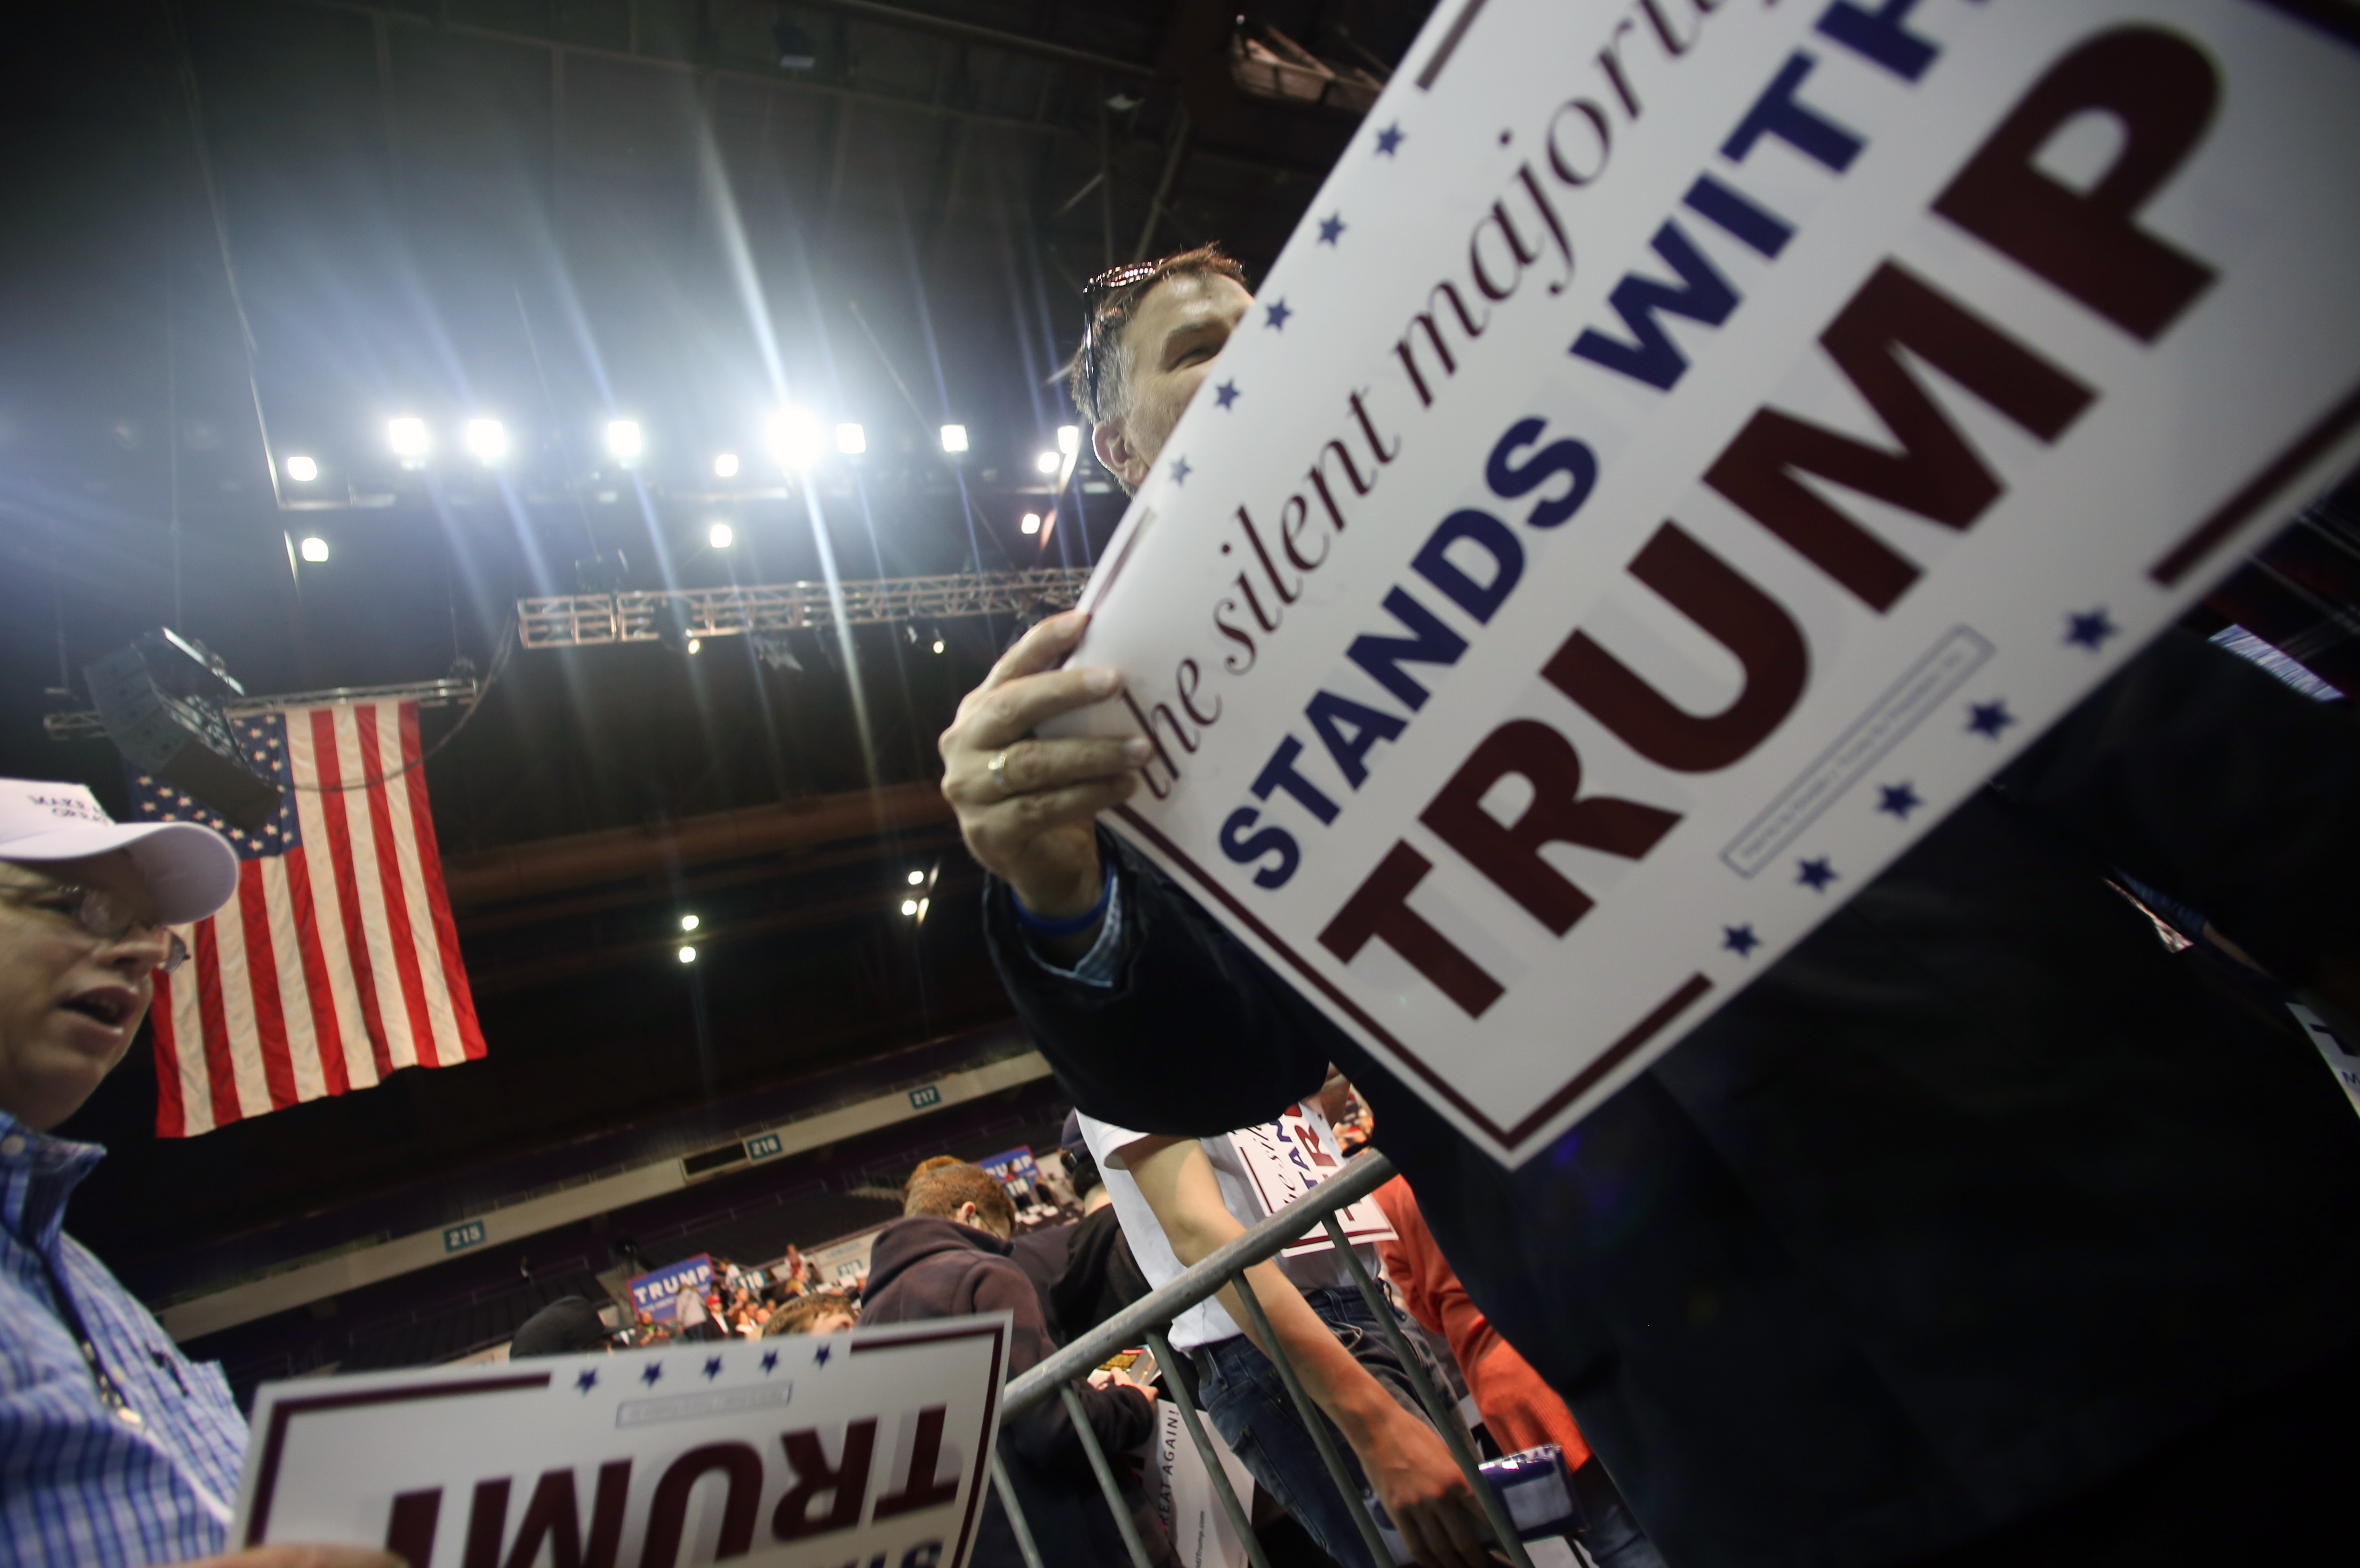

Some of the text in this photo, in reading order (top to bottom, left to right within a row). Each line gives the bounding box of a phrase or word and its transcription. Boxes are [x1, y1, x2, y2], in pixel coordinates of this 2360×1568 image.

[1213, 384, 1401, 675] silent
[1314, 20, 2225, 1022] TRUMP
[1216, 415, 1600, 893] STANDS
[449, 1226, 480, 1247] 215
[633, 1264, 711, 1305] TRUMP
[1162, 1409, 1180, 1476] AGAIN!
